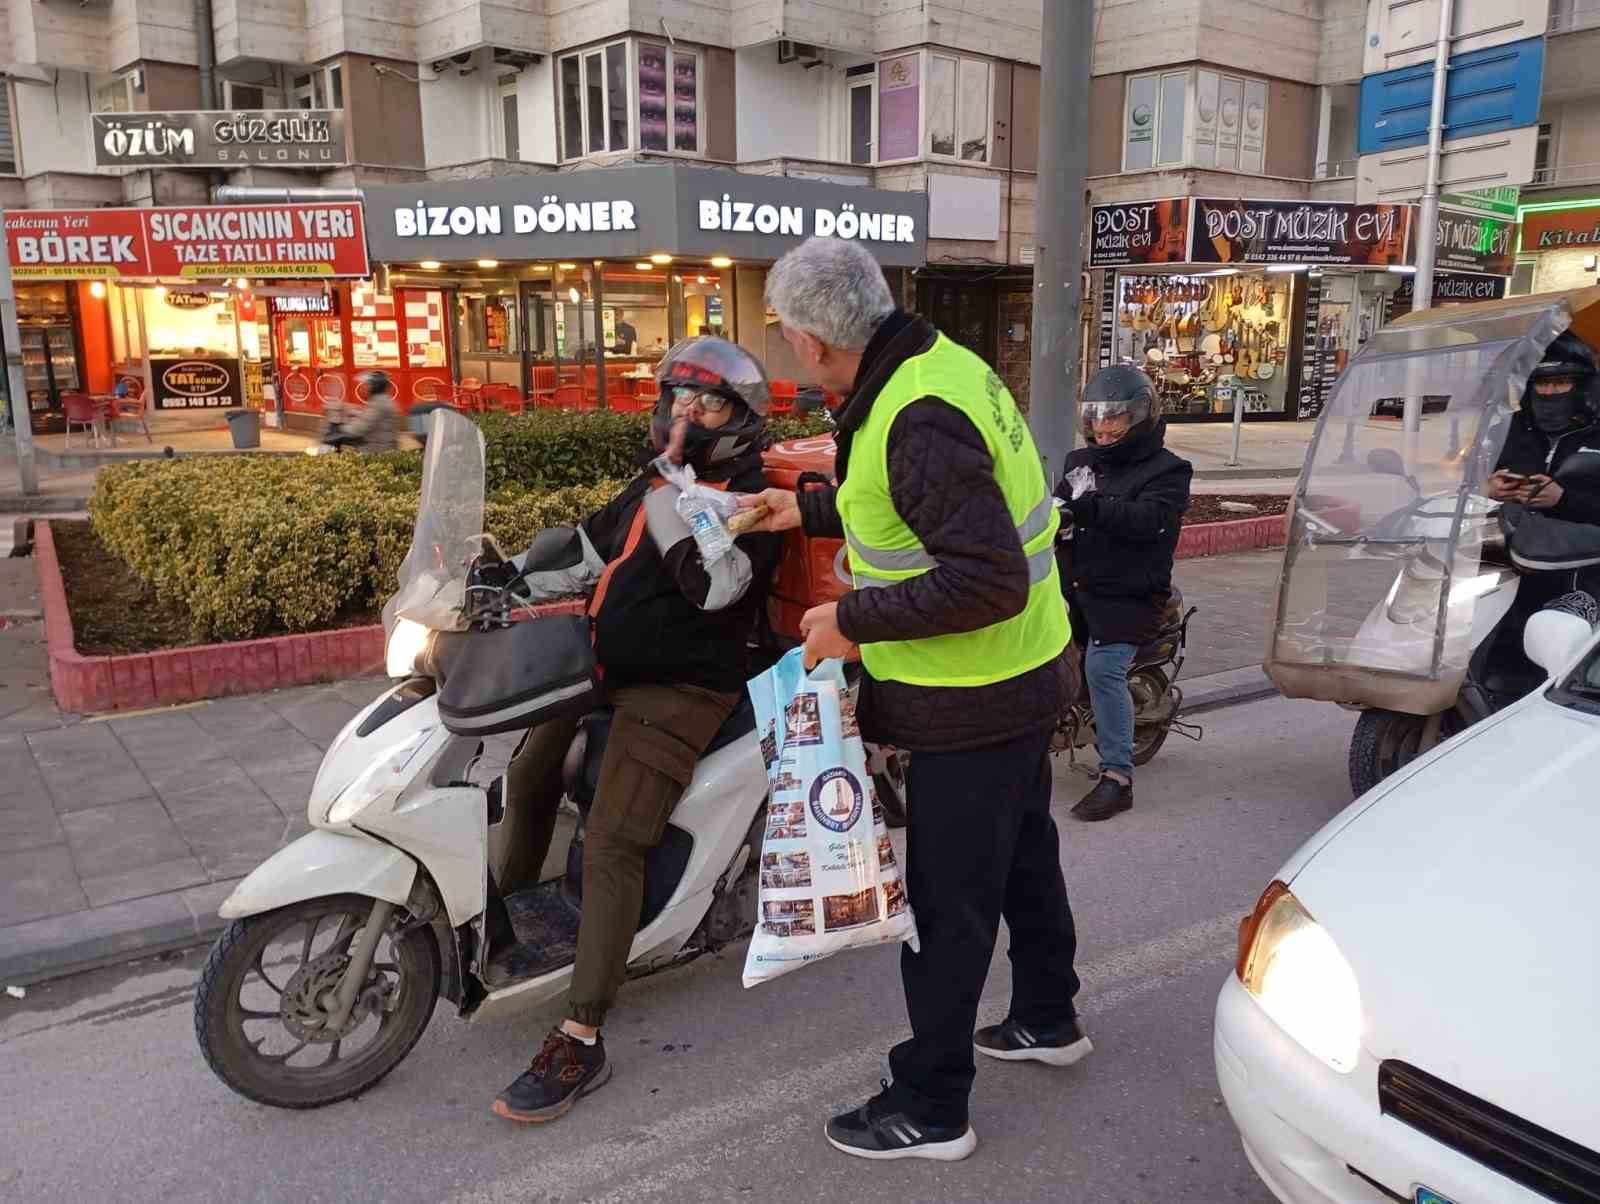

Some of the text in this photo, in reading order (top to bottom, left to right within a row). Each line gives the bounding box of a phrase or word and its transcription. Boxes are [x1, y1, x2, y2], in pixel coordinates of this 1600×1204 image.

[104, 122, 194, 156] ÖZÜM
[215, 112, 330, 143] GÜZELLİK
[218, 149, 331, 160] SALONU
[5, 215, 89, 229] cakcının Yeri
[150, 211, 293, 241] SICAKCININ
[395, 195, 637, 237] BİZON DÖNER
[699, 193, 914, 242] BİZON DÖNER
[1094, 204, 1156, 234] DOST
[1205, 207, 1278, 239] DOST
[1274, 206, 1348, 244] MÜZİK
[16, 231, 139, 263] BÖREK
[174, 242, 336, 263] TAZE TATLI FIRINI
[168, 373, 197, 385] TAT
